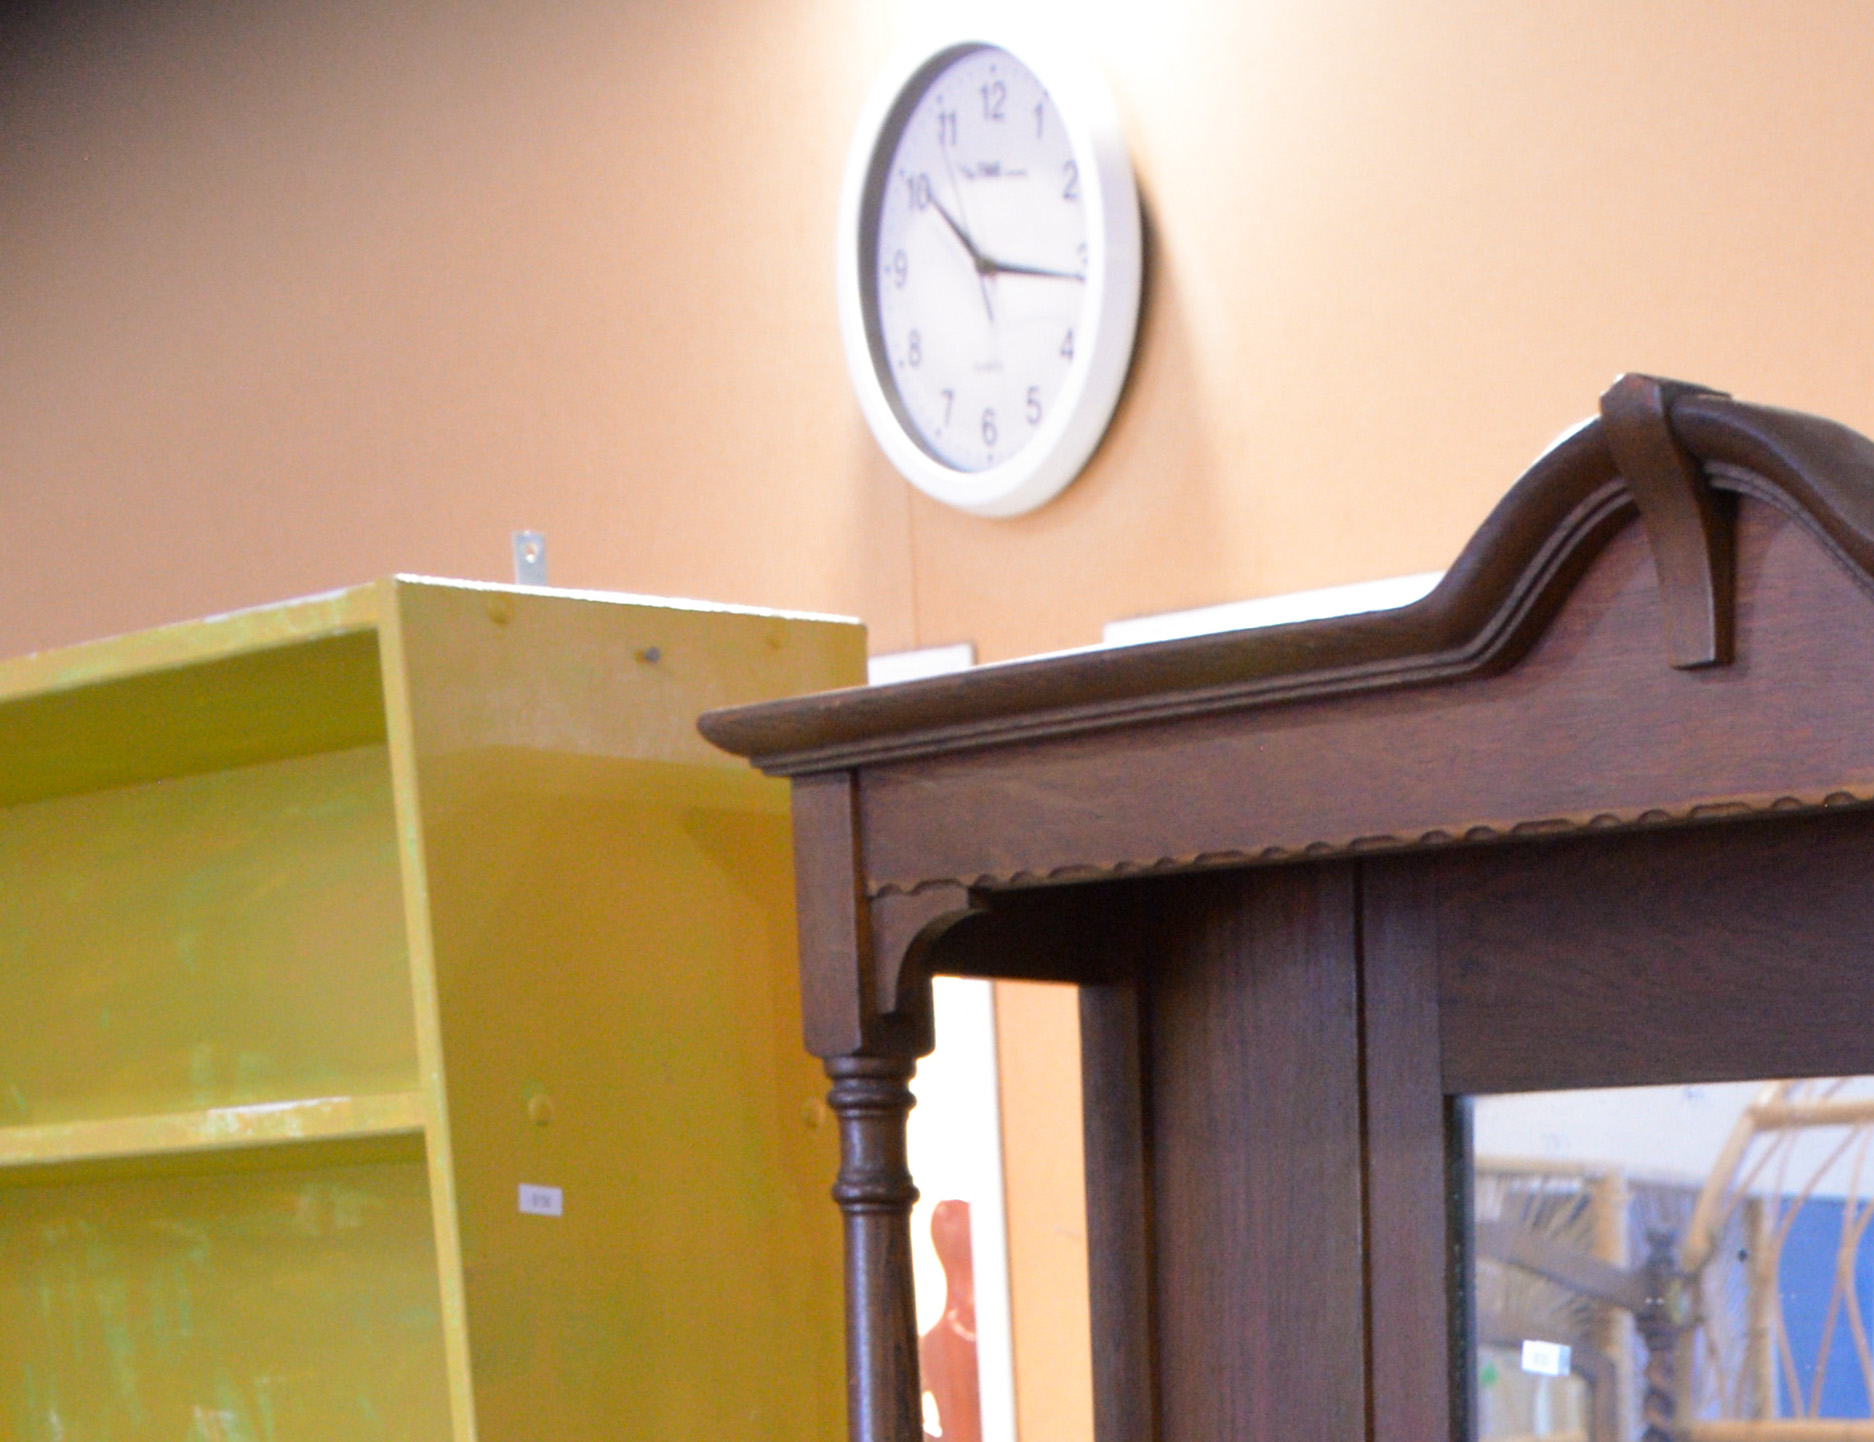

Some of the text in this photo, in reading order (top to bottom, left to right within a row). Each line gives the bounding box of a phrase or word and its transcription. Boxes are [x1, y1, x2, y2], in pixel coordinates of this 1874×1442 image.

[980, 79, 1007, 121] 12
[938, 108, 958, 147] 11
[1034, 102, 1044, 140] 1
[906, 171, 933, 212] 10
[1062, 158, 1080, 200] 2
[893, 248, 909, 290] 9
[907, 327, 922, 369] 8
[1059, 326, 1075, 364] 4
[941, 387, 955, 427] 7
[1026, 384, 1043, 425] 5
[981, 406, 998, 447] 6
